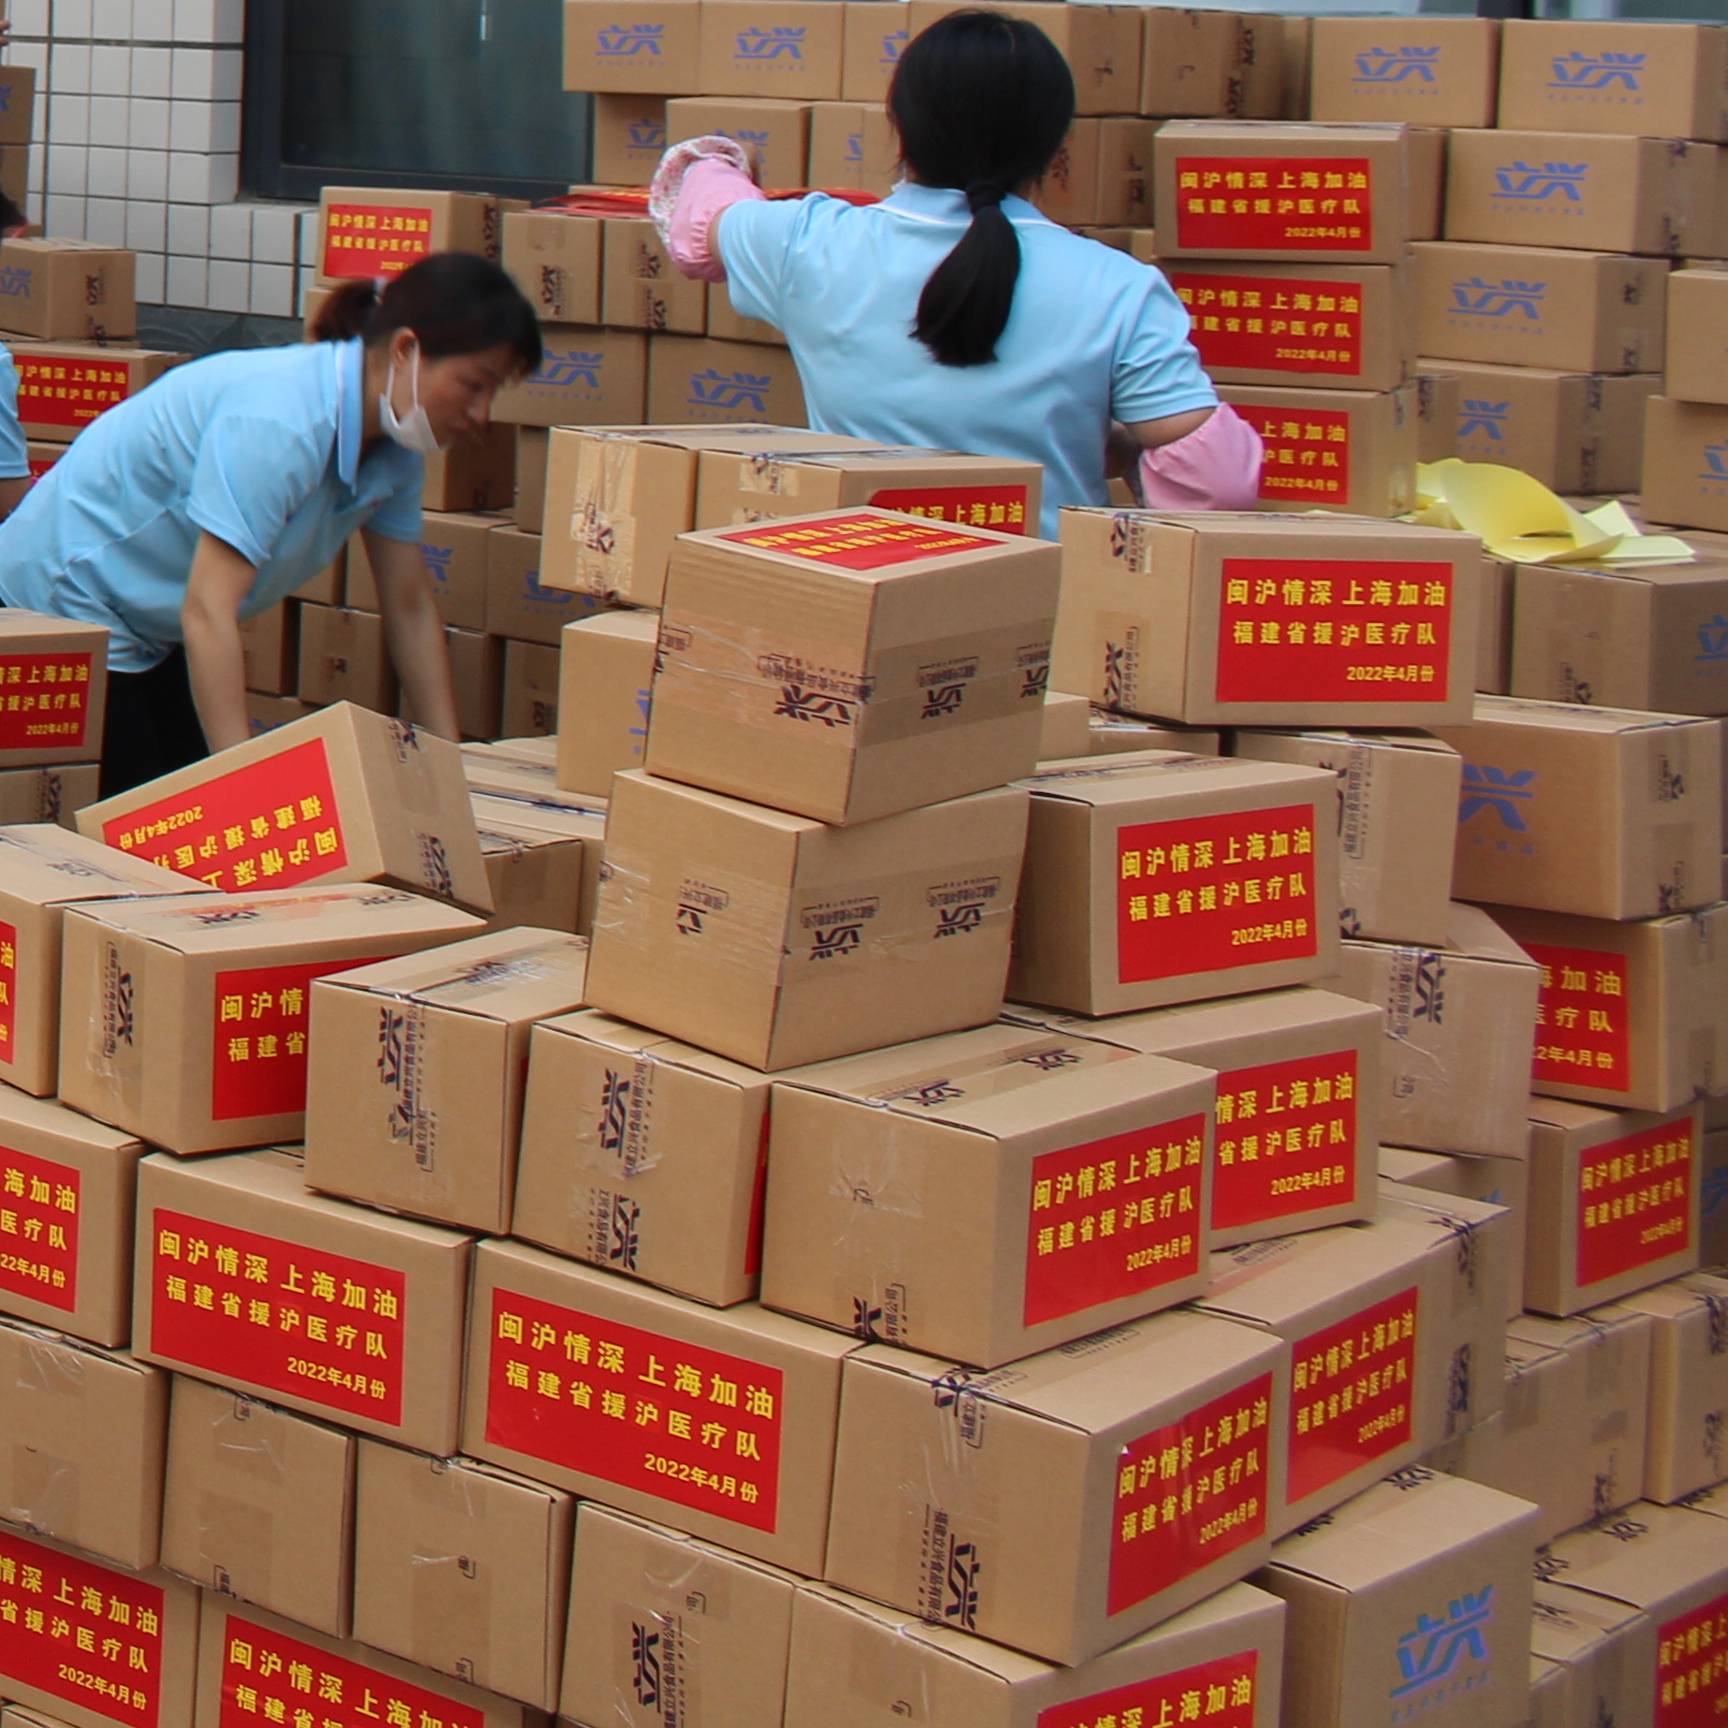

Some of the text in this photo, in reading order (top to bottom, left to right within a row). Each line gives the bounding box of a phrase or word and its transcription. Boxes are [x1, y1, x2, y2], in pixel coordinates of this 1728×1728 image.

[1187, 198, 1360, 214] 福建省援沪医疗队
[1284, 226, 1361, 238] 2022年4月份
[1233, 620, 1436, 646] 福建省援沪医疗队
[1346, 664, 1434, 682] 2022年4月份
[1128, 872, 1306, 921] 福建省援沪医疗队
[1231, 918, 1307, 945] 2022年4月份
[1270, 1165, 1345, 1195] 2022年4月份
[1037, 1185, 1193, 1255] 福建省援沪医疗队
[1126, 1234, 1192, 1271] 2022年4月份
[166, 1274, 387, 1359] 福建省援沪医疗队
[287, 1356, 386, 1399] 2022年4月份
[505, 1359, 760, 1461] 福建省援沪医疗队
[644, 1453, 758, 1503] 2022年4月份
[58, 1663, 146, 1710] 2022年4月份
